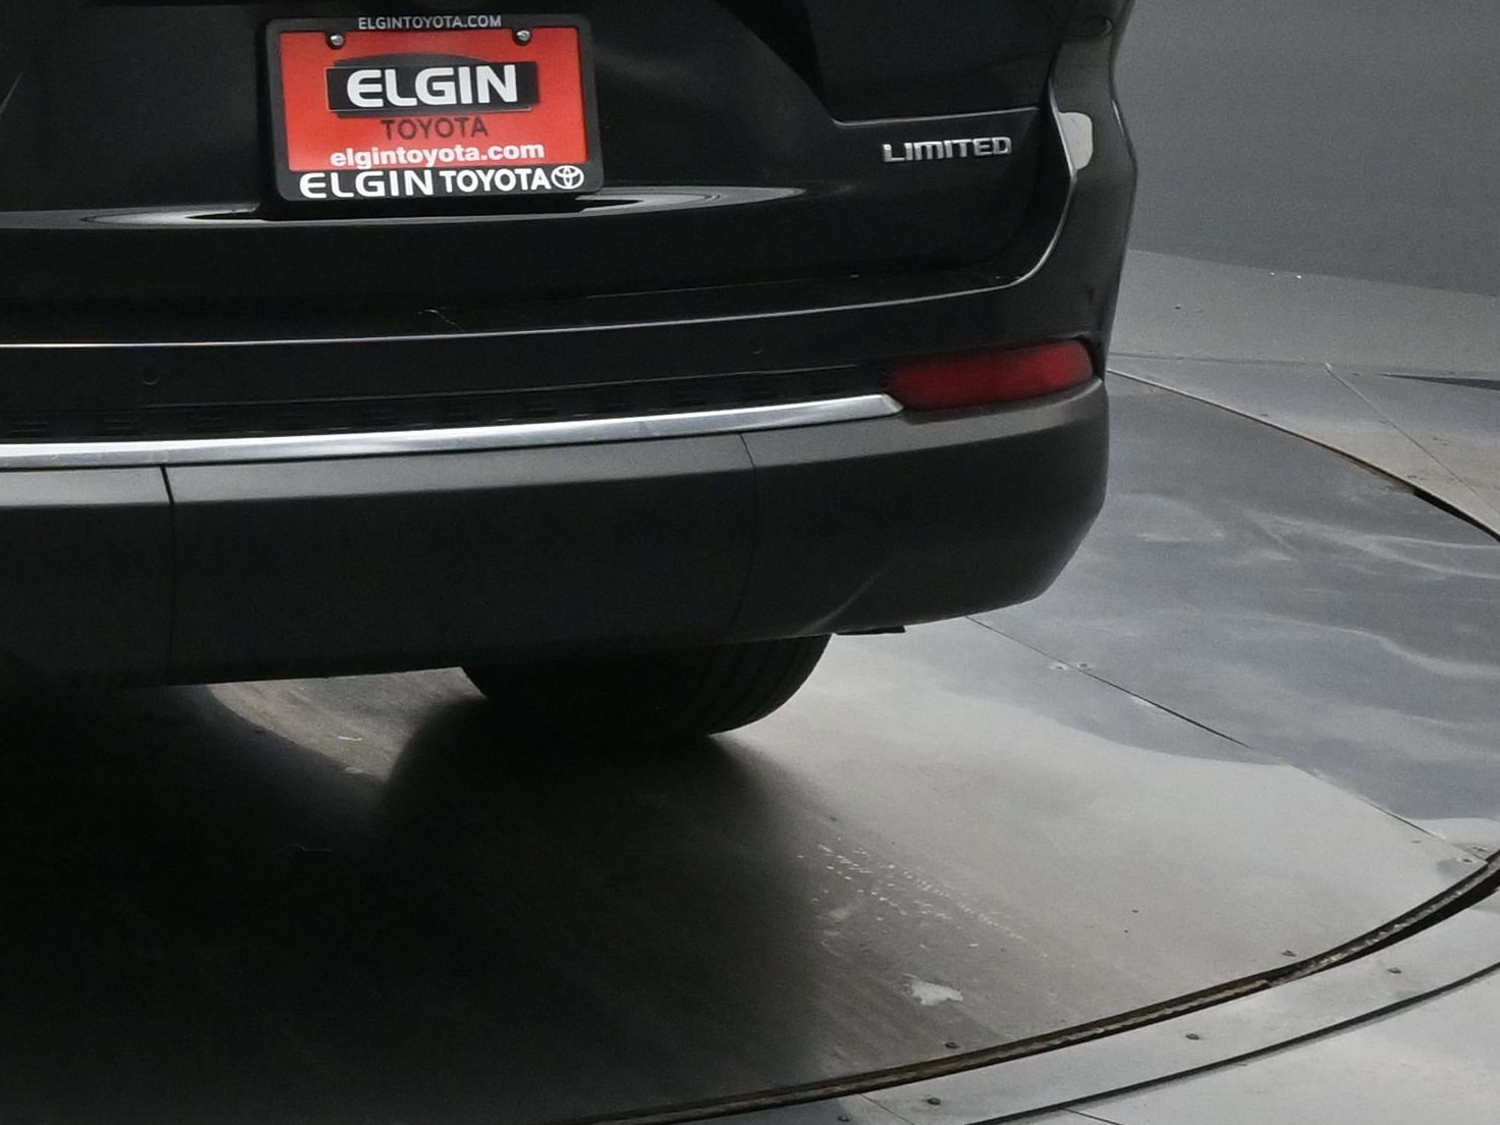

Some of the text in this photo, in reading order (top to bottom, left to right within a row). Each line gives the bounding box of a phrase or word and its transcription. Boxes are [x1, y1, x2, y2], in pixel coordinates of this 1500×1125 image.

[359, 15, 501, 29] ELGINTOYOTA.COM
[347, 64, 517, 107] ELGIN
[381, 117, 488, 140] TOYOTA
[331, 144, 544, 169] elgintoyota.com
[882, 136, 1013, 163] LIMITED
[300, 168, 552, 198] ELGIN TOYOTA
